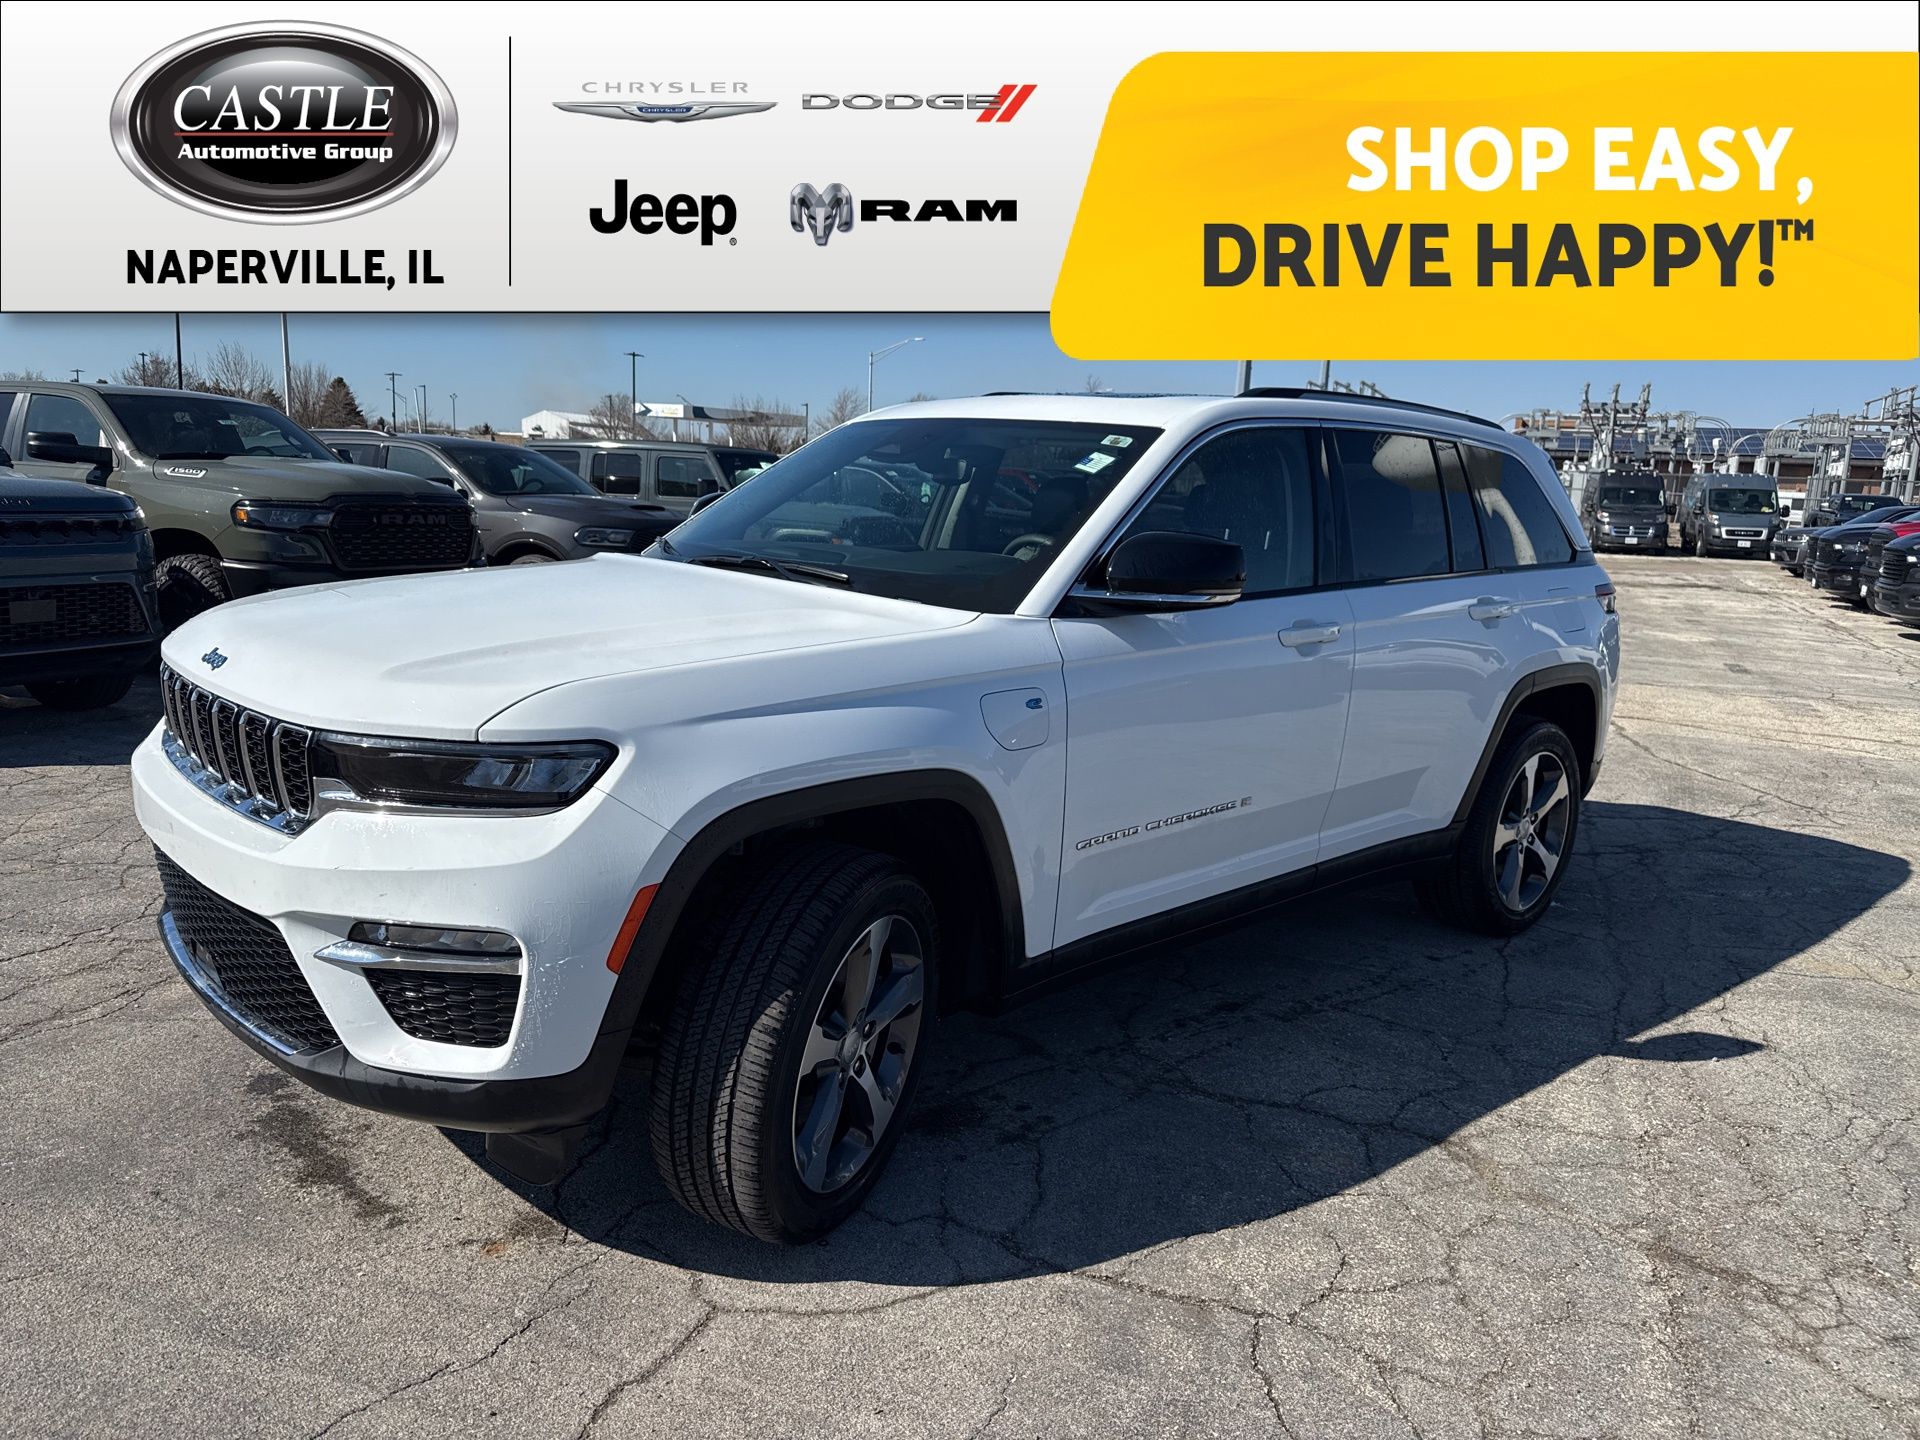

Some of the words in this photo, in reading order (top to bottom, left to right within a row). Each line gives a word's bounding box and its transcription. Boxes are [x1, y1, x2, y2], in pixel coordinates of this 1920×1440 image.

[381, 514, 446, 525] RAM
[1076, 826, 1142, 851] GRAND
[1145, 800, 1238, 832] CHEROKEE
